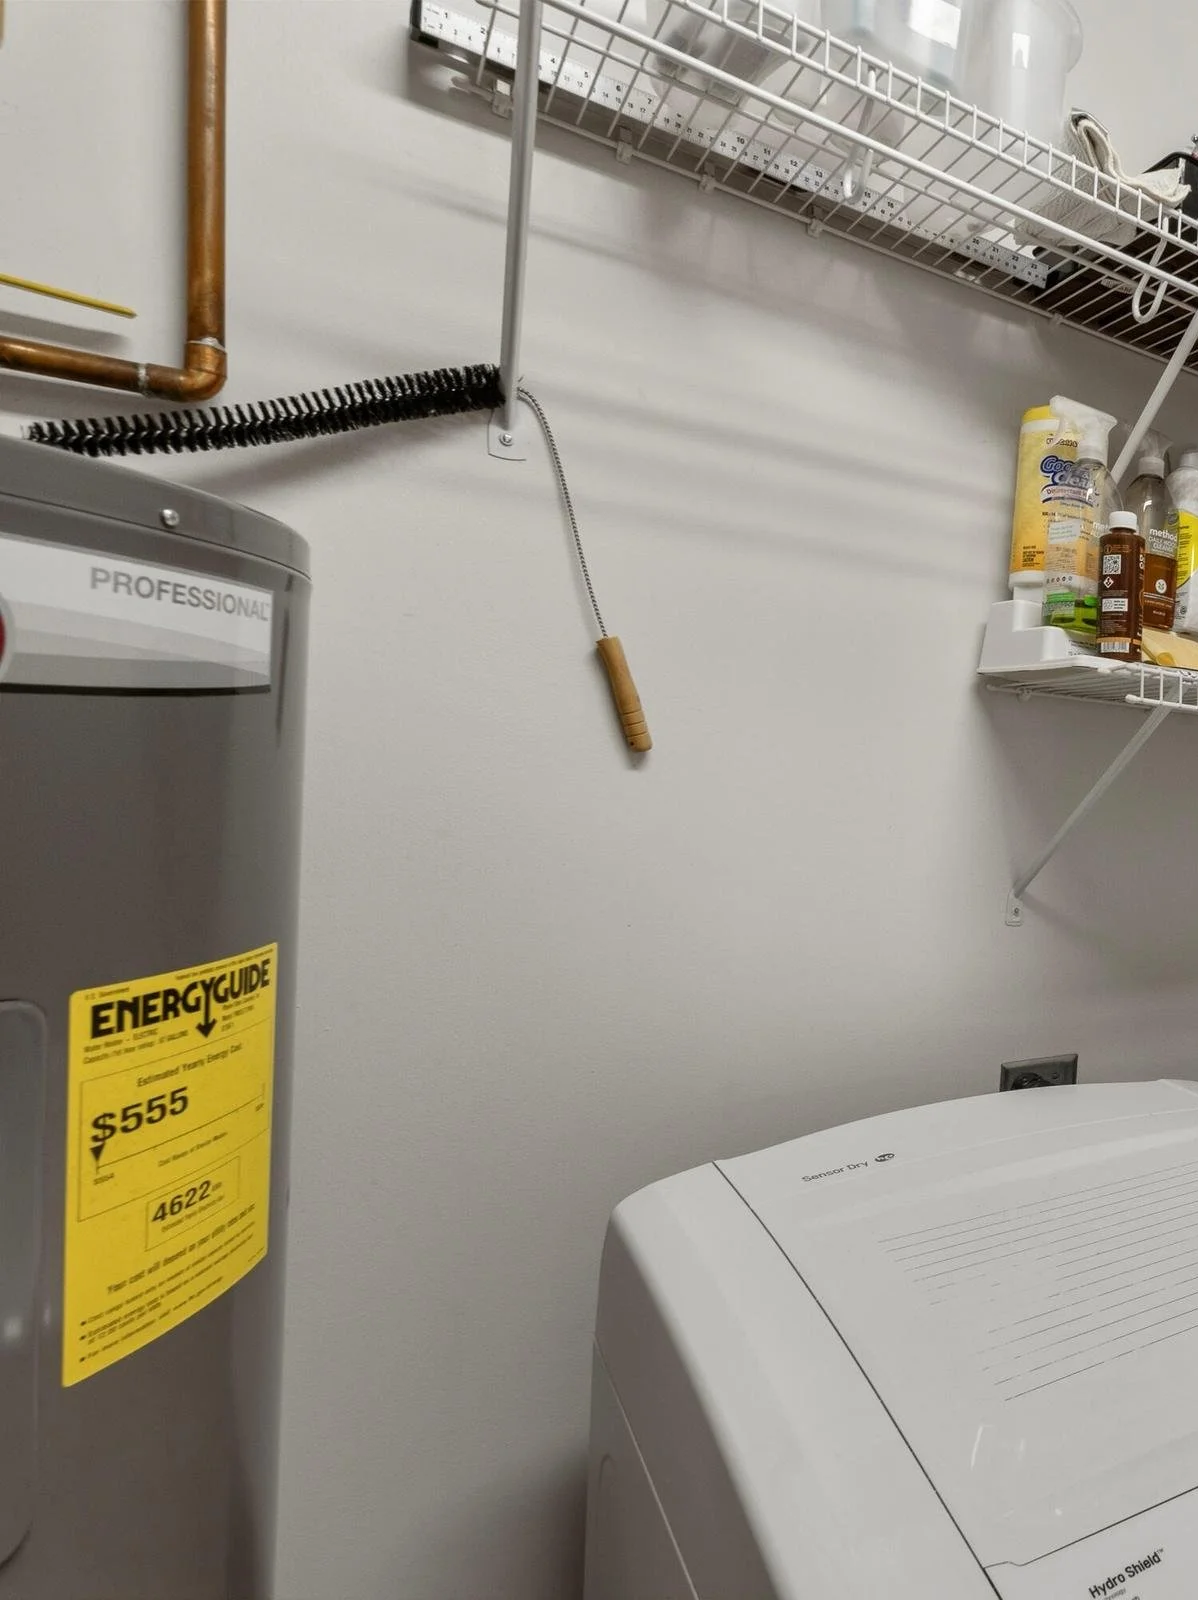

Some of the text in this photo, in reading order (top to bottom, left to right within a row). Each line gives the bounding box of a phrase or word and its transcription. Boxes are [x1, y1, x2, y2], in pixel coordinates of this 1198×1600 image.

[90, 566, 269, 621] PROFESSIONAL
[91, 958, 271, 1040] ENERGYGUIDE
[137, 1065, 180, 1087] Estimated
[91, 1087, 190, 1144] $555
[801, 1161, 869, 1183] Sensor Dry
[152, 1180, 211, 1222] 4622
[1088, 1573, 1126, 1599] Hydro
